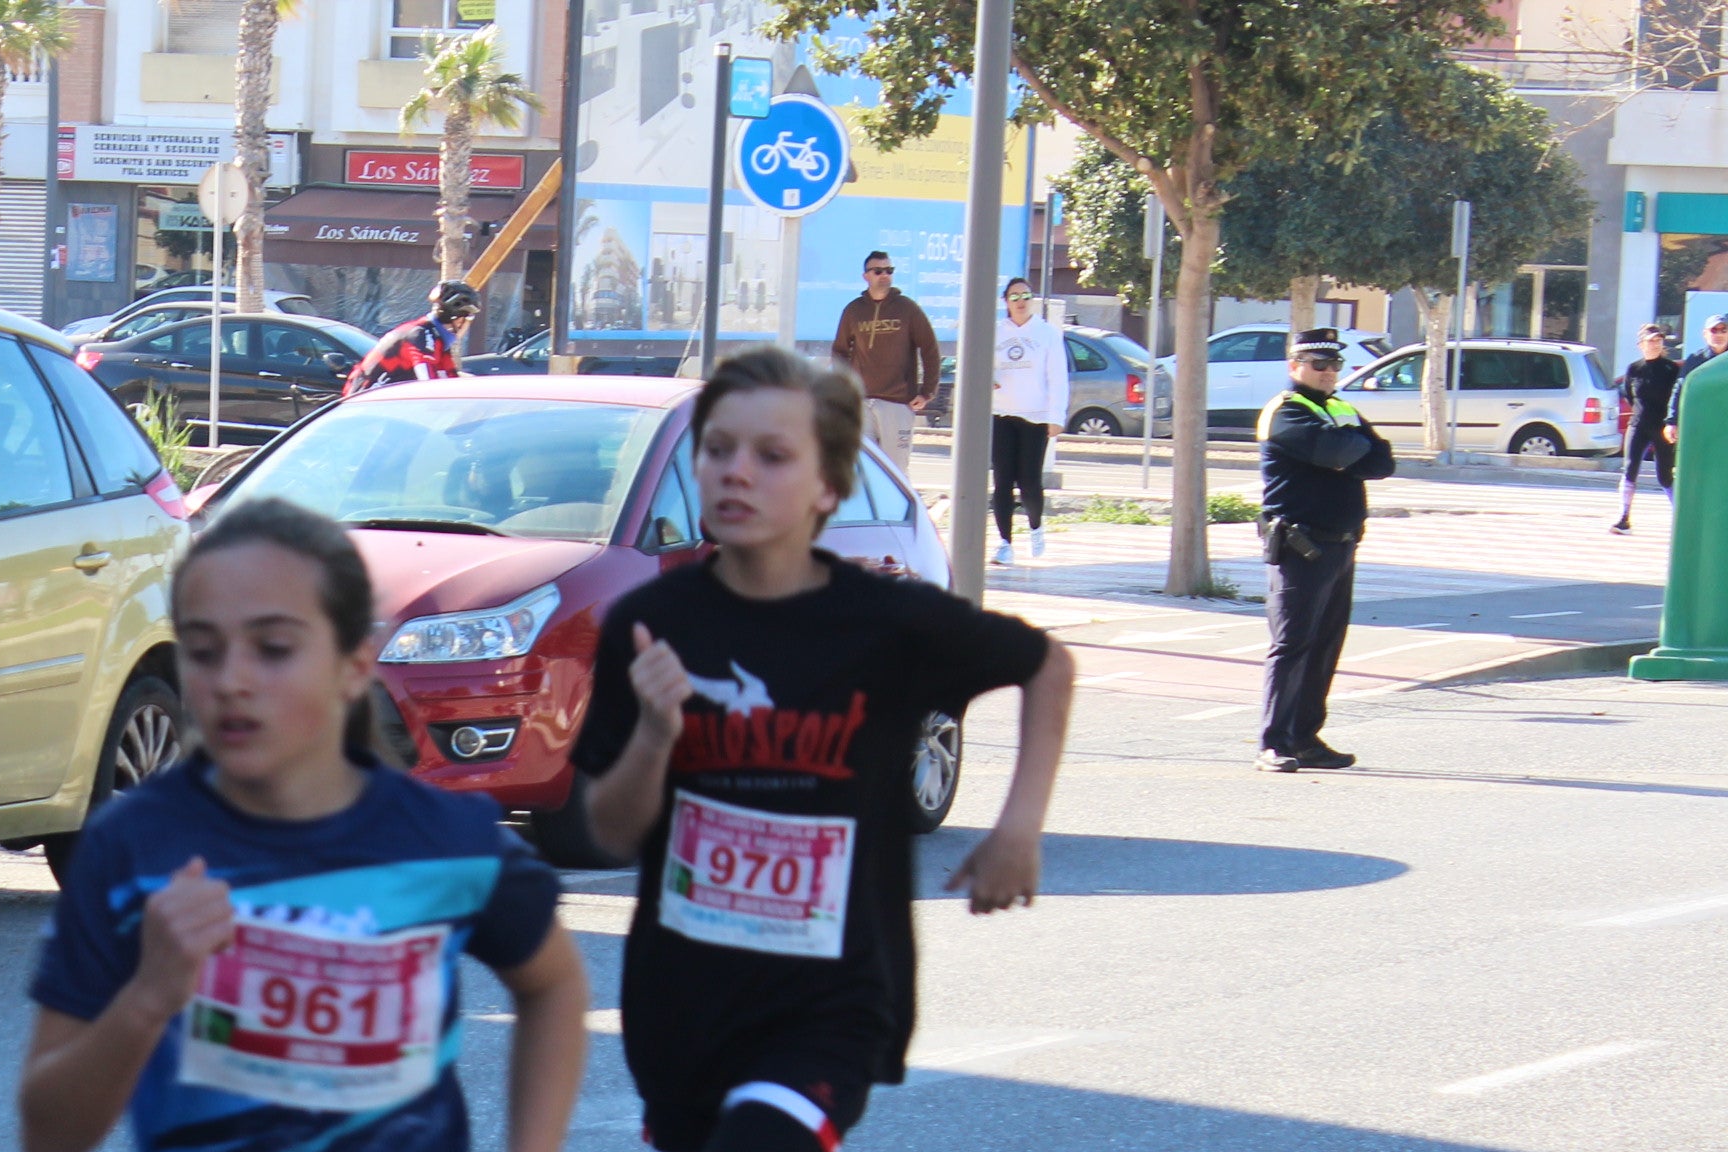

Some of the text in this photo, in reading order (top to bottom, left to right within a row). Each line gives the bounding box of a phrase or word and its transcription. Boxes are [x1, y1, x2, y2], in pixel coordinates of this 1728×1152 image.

[93, 133, 142, 142] SERVICIOS
[207, 136, 220, 145] DE
[165, 144, 220, 154] SEGURIDAD
[155, 158, 173, 167] AND
[145, 168, 190, 177] SERVICES
[358, 160, 491, 183] Los Sánez
[314, 224, 420, 243] Los Sánchez
[708, 846, 801, 896] 970
[260, 976, 381, 1037] 961
